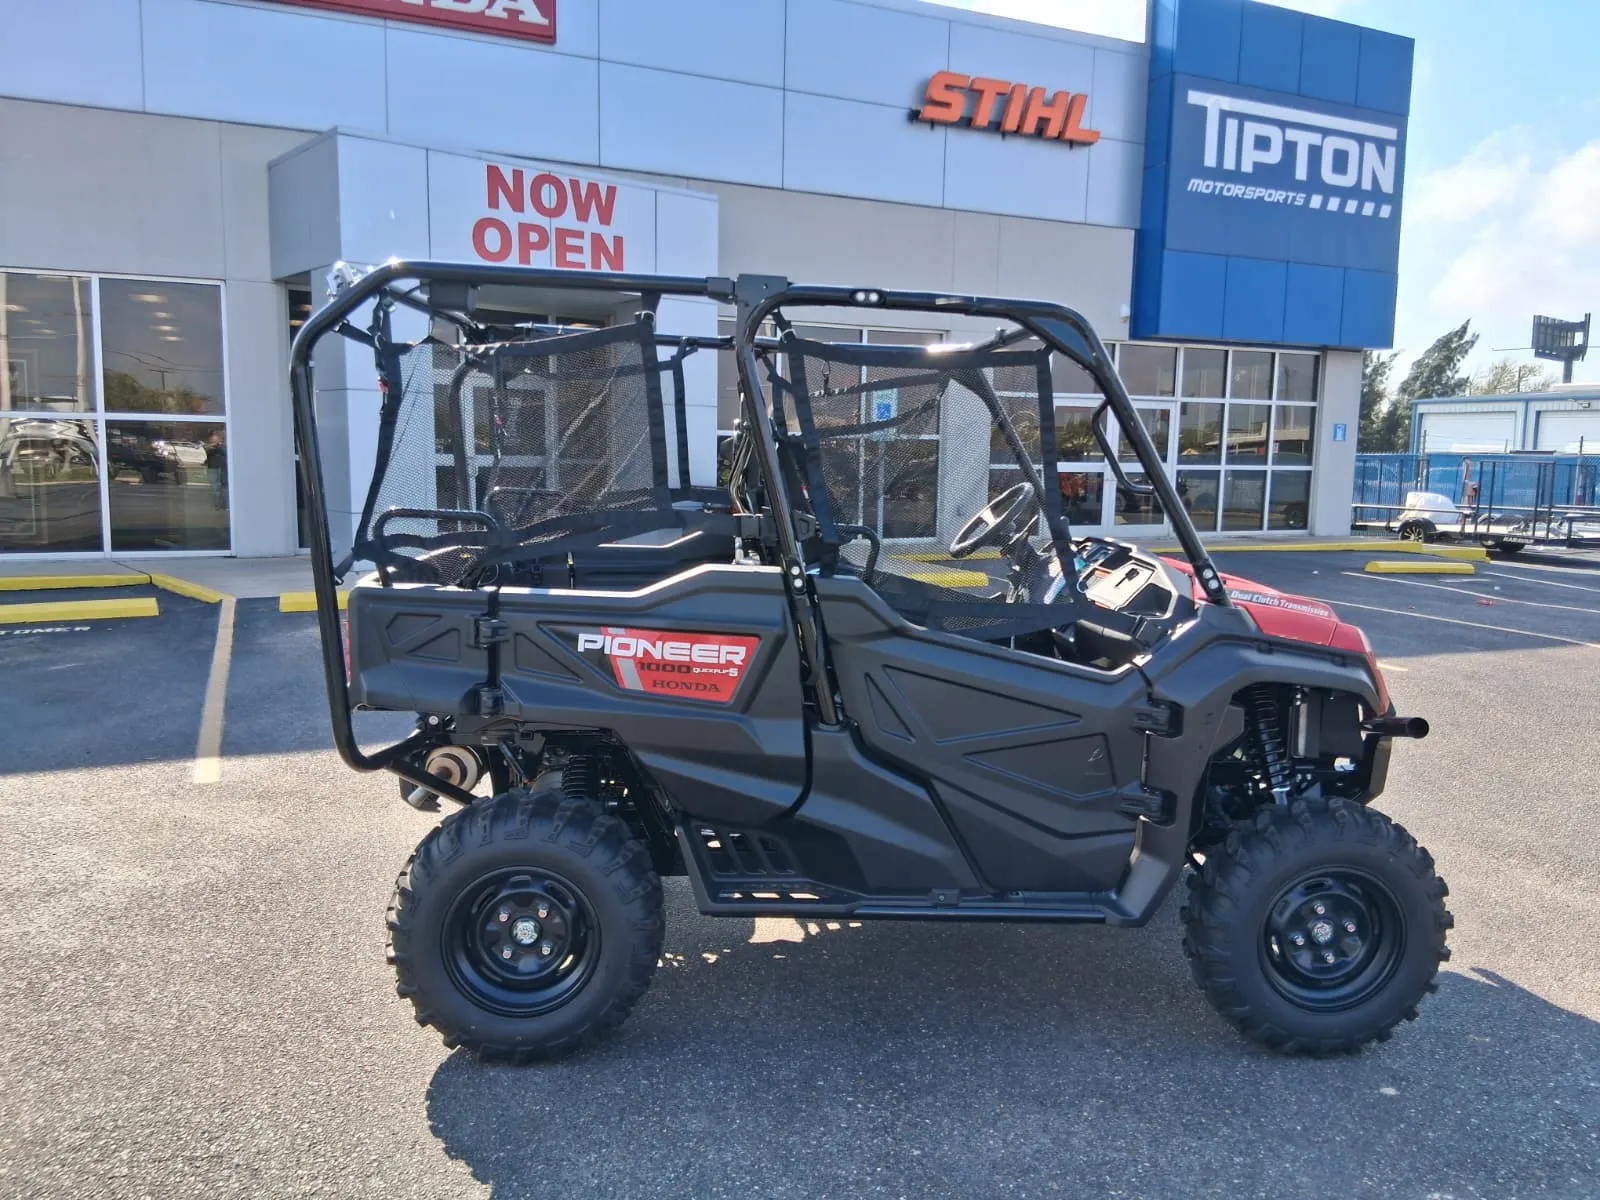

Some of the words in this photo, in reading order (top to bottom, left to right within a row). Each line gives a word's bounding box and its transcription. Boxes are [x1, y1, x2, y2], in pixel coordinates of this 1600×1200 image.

[919, 70, 1101, 144] STIHL
[1187, 90, 1398, 194] TIPTON
[486, 164, 617, 226] NOW
[1187, 178, 1306, 206] MOTORSPORTS
[472, 217, 624, 272] OPEN
[1230, 590, 1252, 601] Dual
[1253, 594, 1280, 607] Clutch
[577, 633, 747, 665] PIONEER
[639, 661, 691, 674] 1000
[651, 679, 721, 693] HONDA
